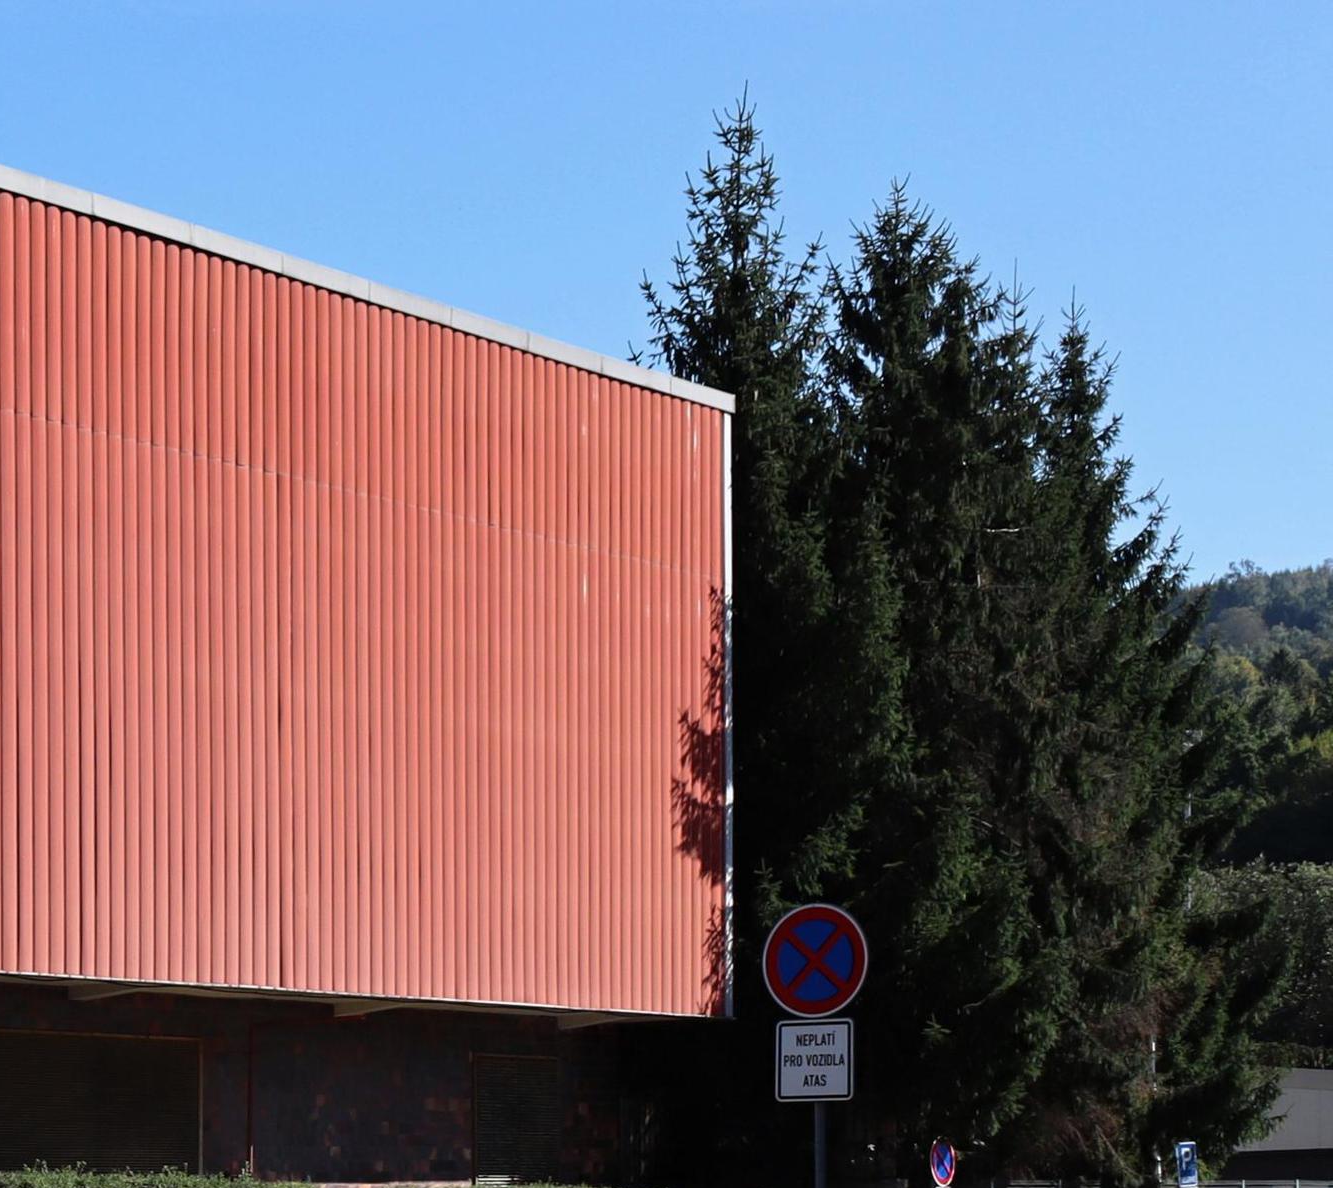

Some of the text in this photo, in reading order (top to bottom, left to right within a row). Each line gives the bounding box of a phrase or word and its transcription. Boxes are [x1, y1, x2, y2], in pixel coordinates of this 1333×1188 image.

[795, 1030, 836, 1047] NEPLATÍ
[783, 1053, 845, 1067] PRO VOZIDLA
[803, 1074, 828, 1088] ATAS
[1181, 1147, 1193, 1171] P
